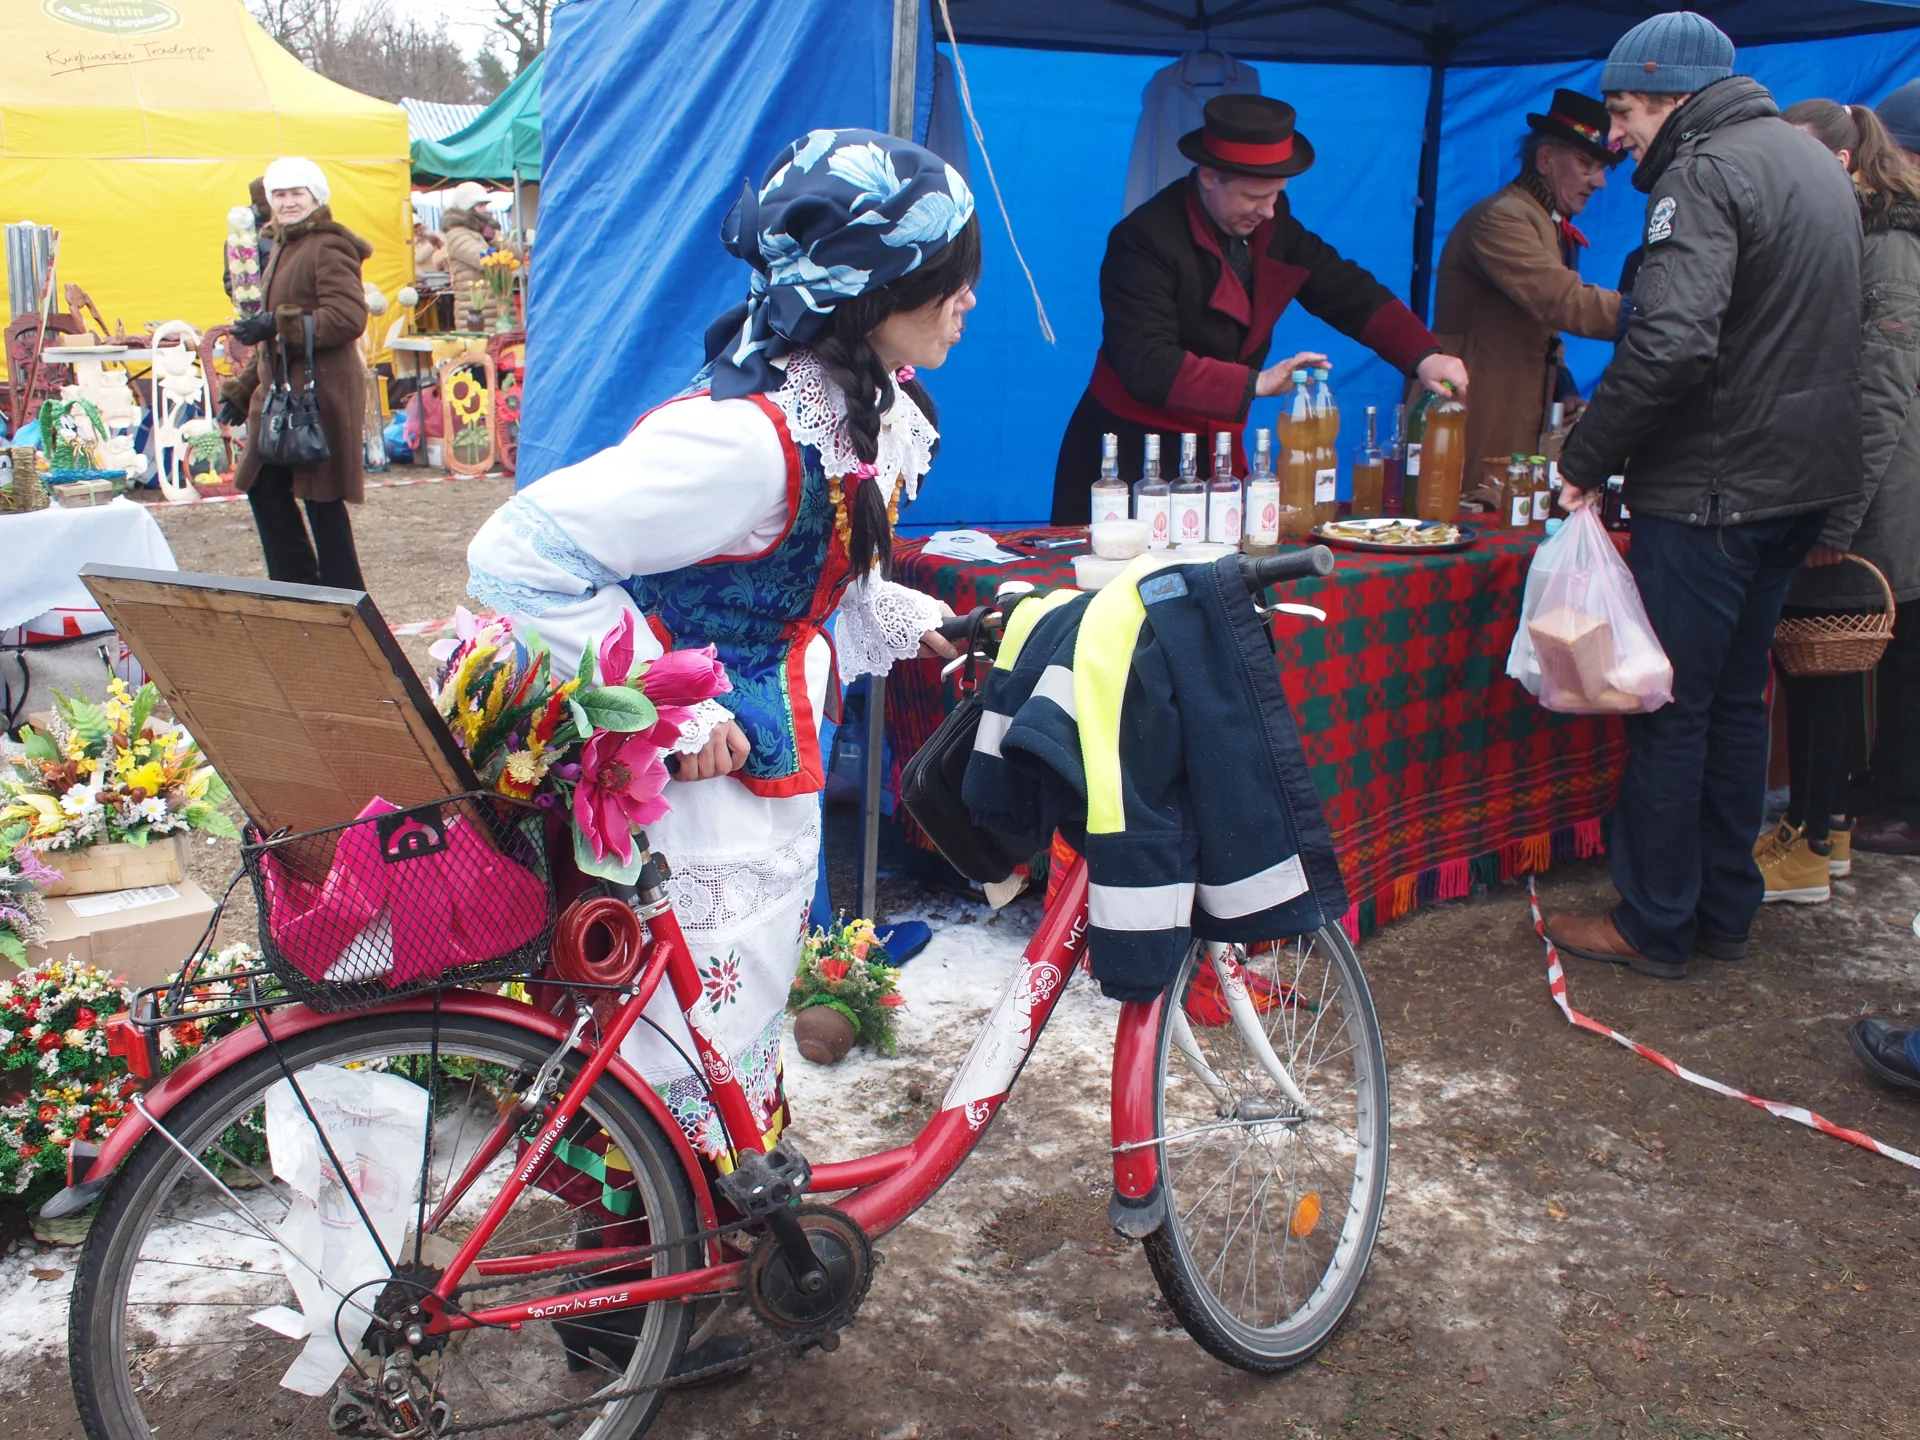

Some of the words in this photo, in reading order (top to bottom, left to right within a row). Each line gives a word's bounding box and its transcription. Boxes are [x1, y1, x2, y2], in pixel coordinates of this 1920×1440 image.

[984, 1041, 1002, 1068] Cityline
[519, 1115, 568, 1182] www.mifa.de
[545, 1303, 573, 1315] CITY
[588, 1292, 629, 1308] STYLE
